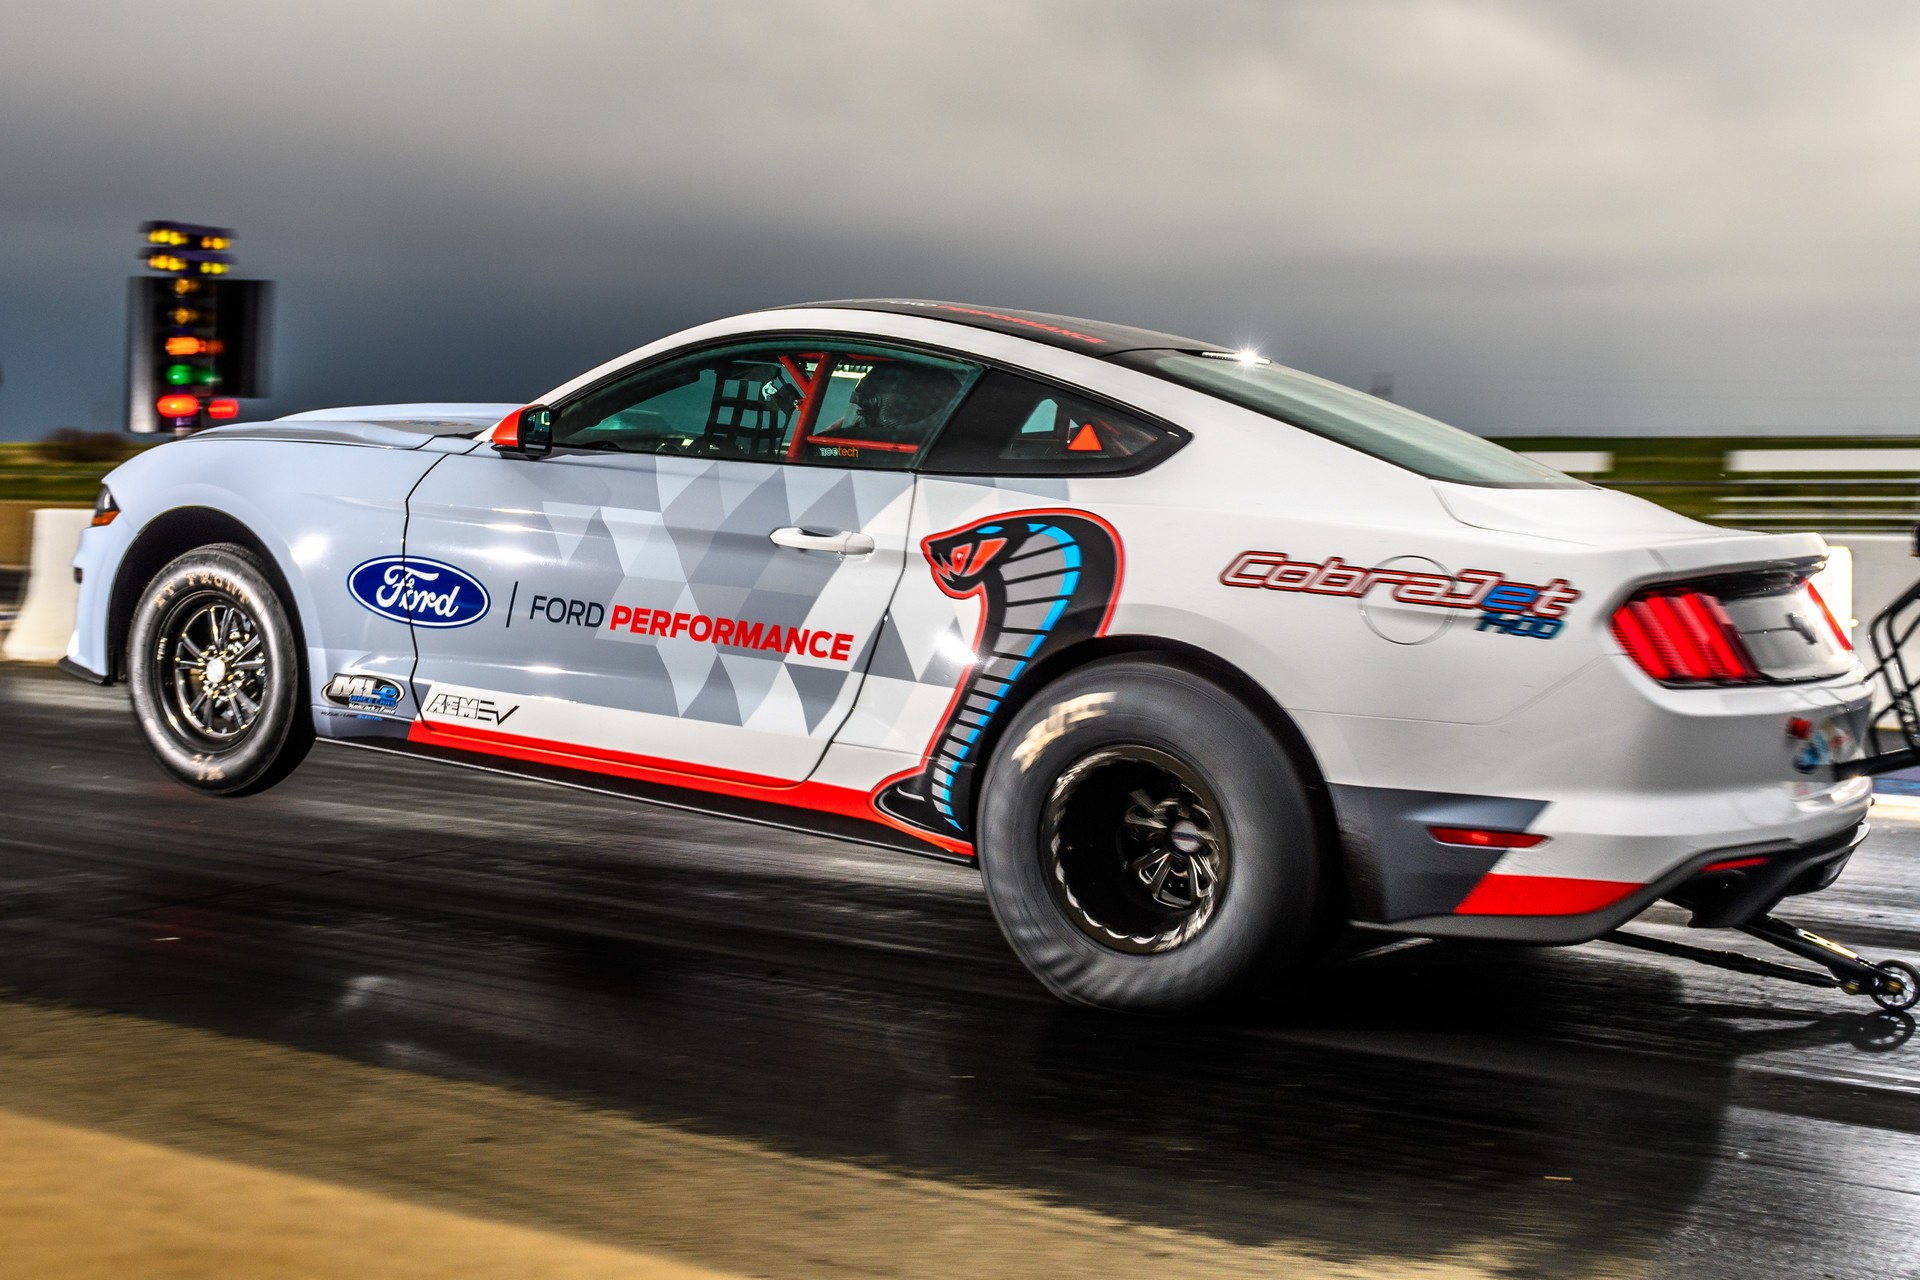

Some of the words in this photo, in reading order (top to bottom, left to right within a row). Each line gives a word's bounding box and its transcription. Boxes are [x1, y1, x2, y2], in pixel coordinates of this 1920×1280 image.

[376, 565, 460, 617] Ford
[530, 595, 605, 628] FORD
[609, 605, 855, 661] PERFORMANCE
